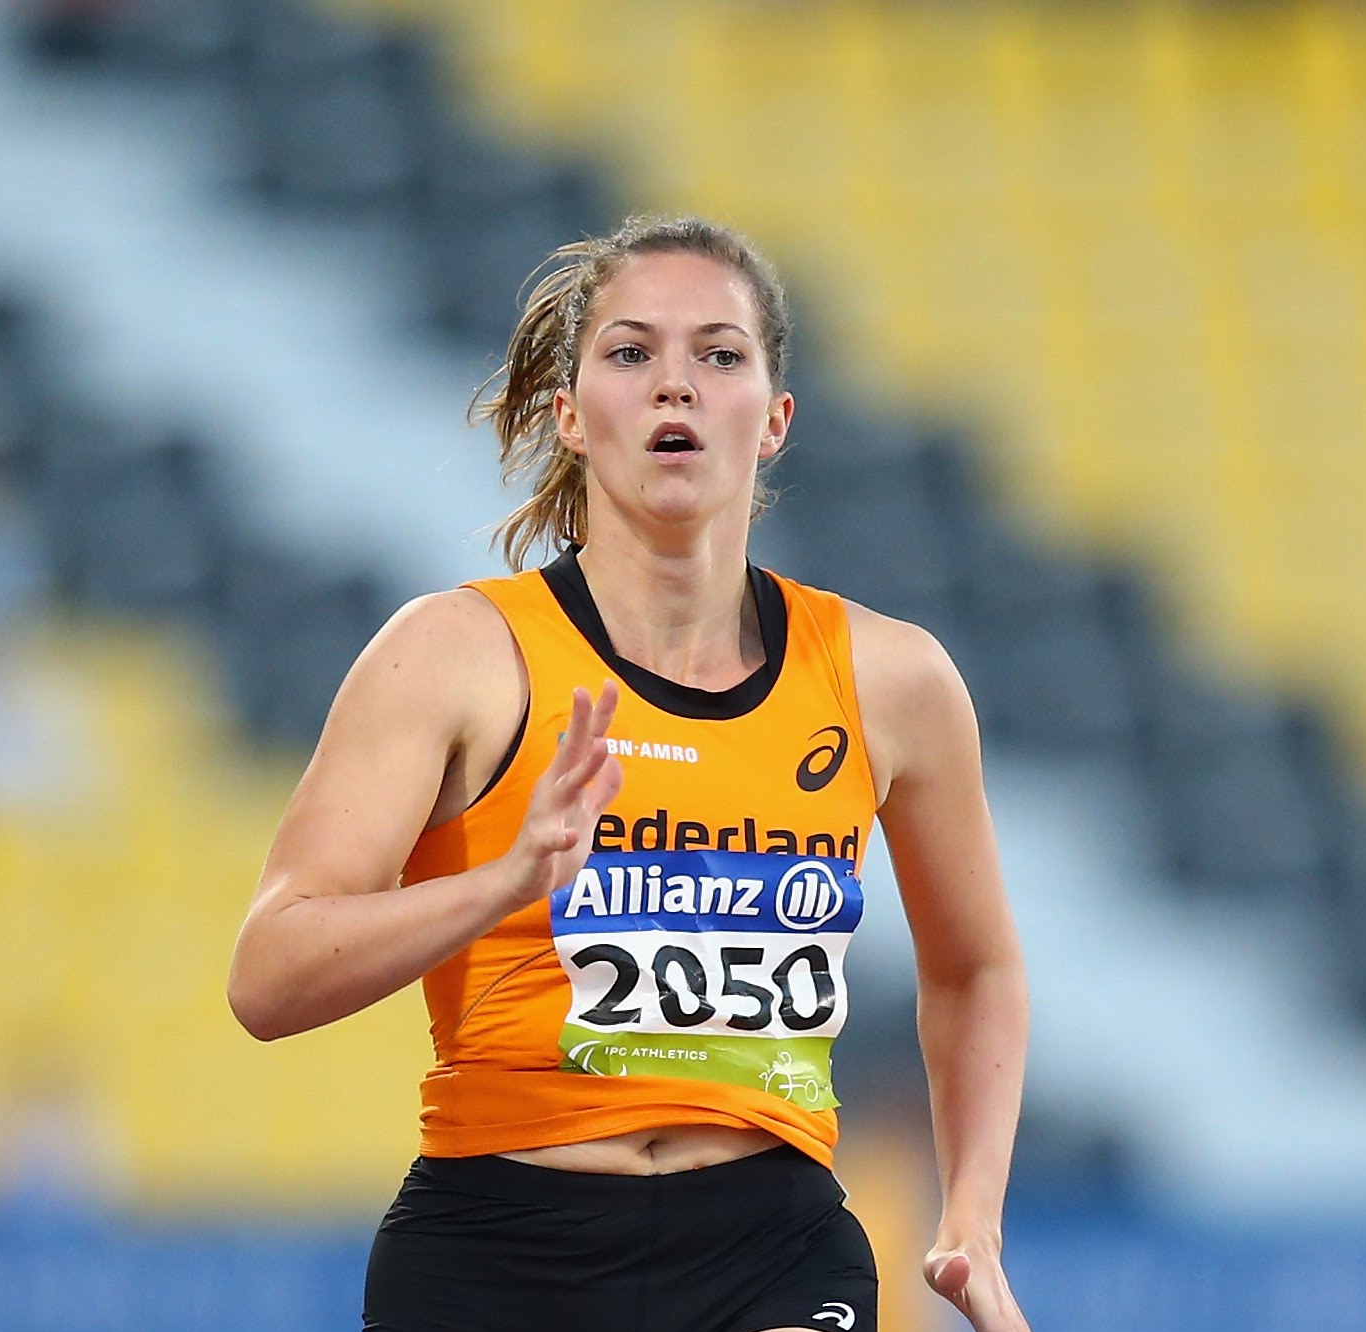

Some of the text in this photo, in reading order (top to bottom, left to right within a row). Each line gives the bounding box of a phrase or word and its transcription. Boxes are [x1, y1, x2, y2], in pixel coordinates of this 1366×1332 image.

[591, 809, 859, 862] ederland
[564, 864, 764, 919] Allianz
[570, 943, 836, 1031] 2050
[605, 1046, 708, 1061] IPC ATHLETICS
